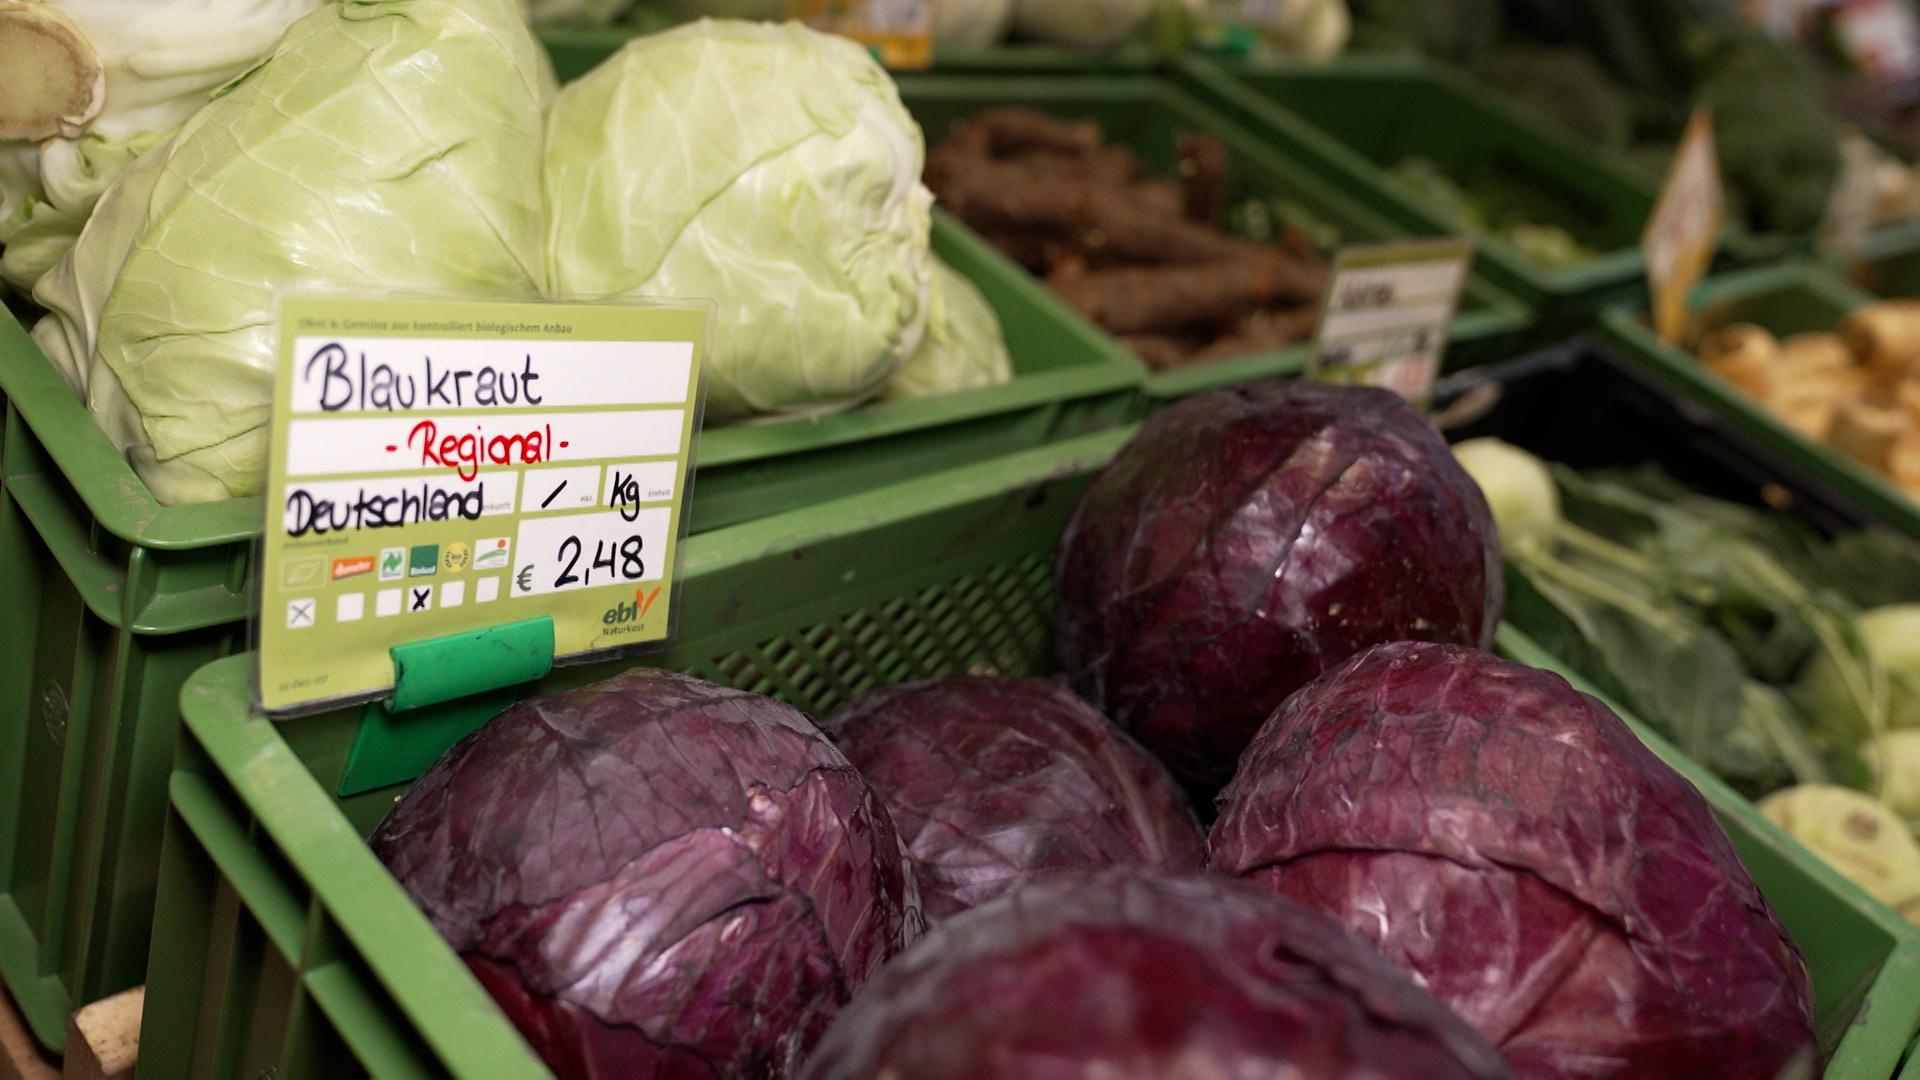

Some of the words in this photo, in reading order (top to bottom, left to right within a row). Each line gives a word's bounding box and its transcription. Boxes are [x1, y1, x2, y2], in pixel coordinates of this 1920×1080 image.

[413, 319, 473, 332] kontrolliert
[476, 321, 541, 335] biologischem
[543, 323, 573, 334] Anbau
[305, 342, 542, 412] Blaukraut
[286, 481, 483, 538] Deutschland
[516, 564, 534, 592] €
[554, 535, 645, 588] 2,48
[602, 601, 637, 625] ebl
[603, 623, 645, 636] Naturkost
